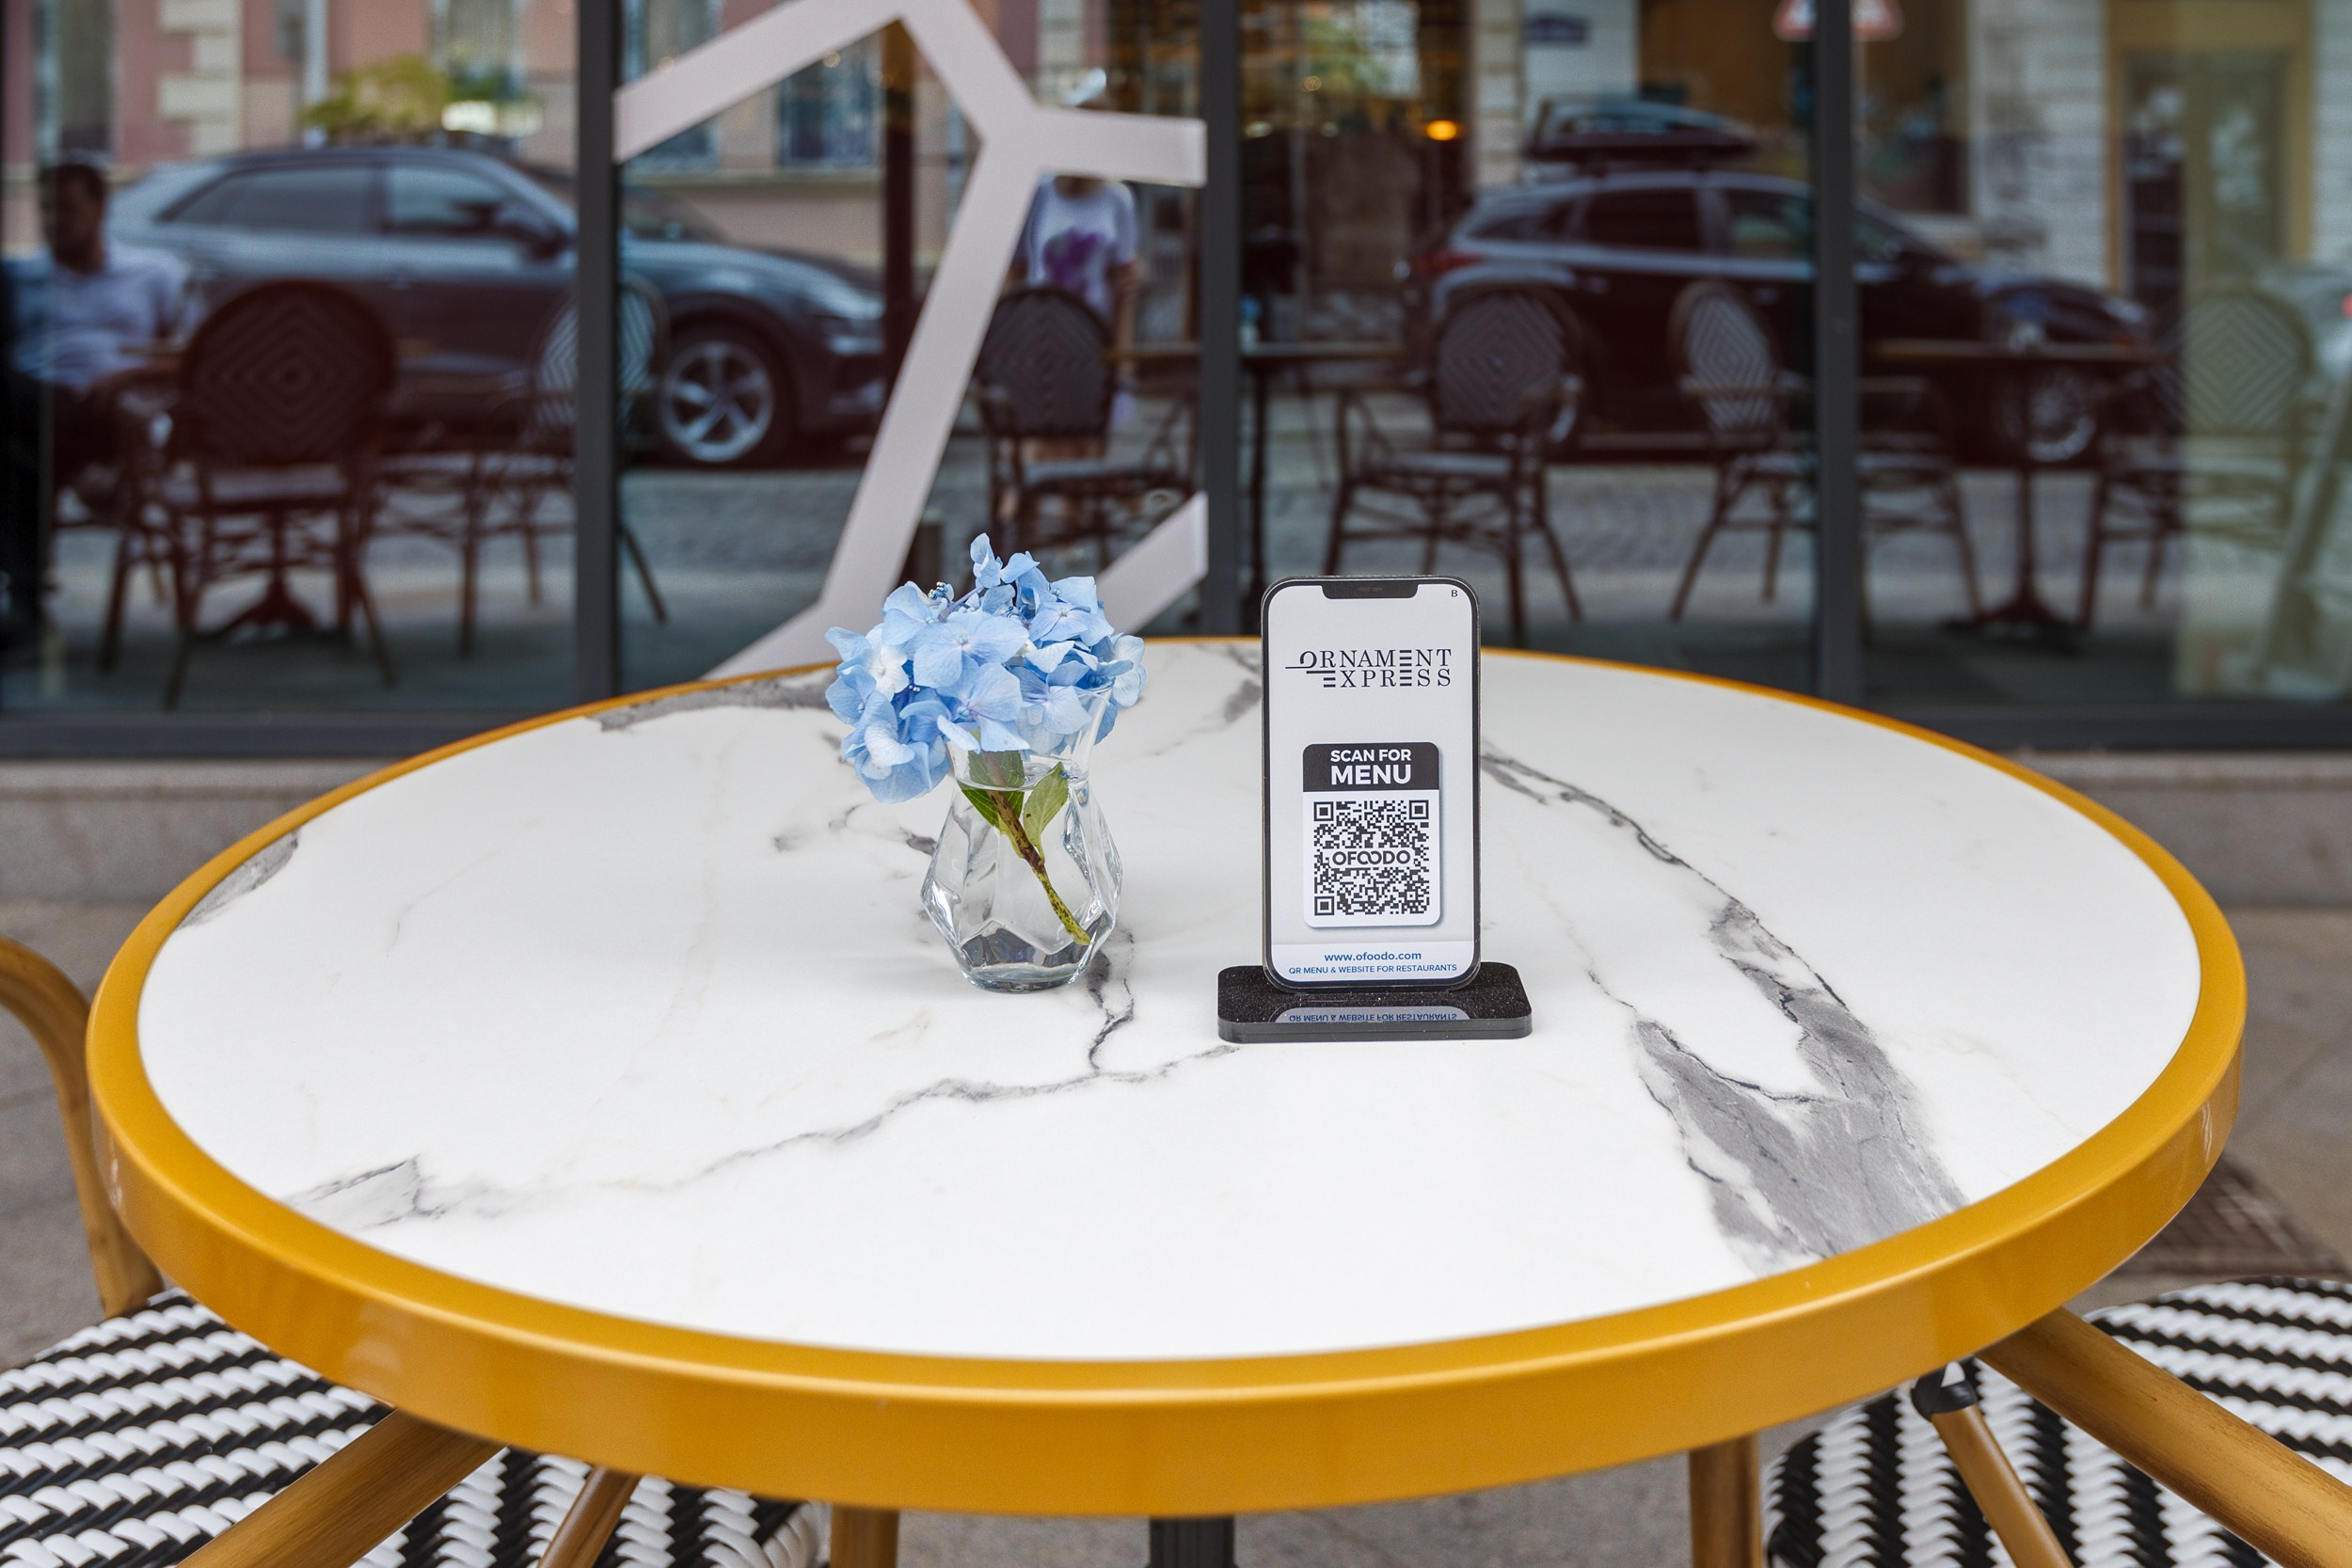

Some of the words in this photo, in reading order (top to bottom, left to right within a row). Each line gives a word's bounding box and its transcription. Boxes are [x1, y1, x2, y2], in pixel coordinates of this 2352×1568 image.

[1451, 589, 1458, 597] B
[1285, 648, 1452, 669] ORNAMENT
[1306, 669, 1452, 689] EXPRESS
[1330, 750, 1375, 762] SCAN
[1379, 749, 1411, 761] FOR
[1331, 764, 1411, 785] MENU
[1332, 849, 1411, 865] OFOODO
[1324, 951, 1422, 961] www.ofoodo.com
[1303, 966, 1328, 974] MENU
[1339, 965, 1375, 974] WEBSITE
